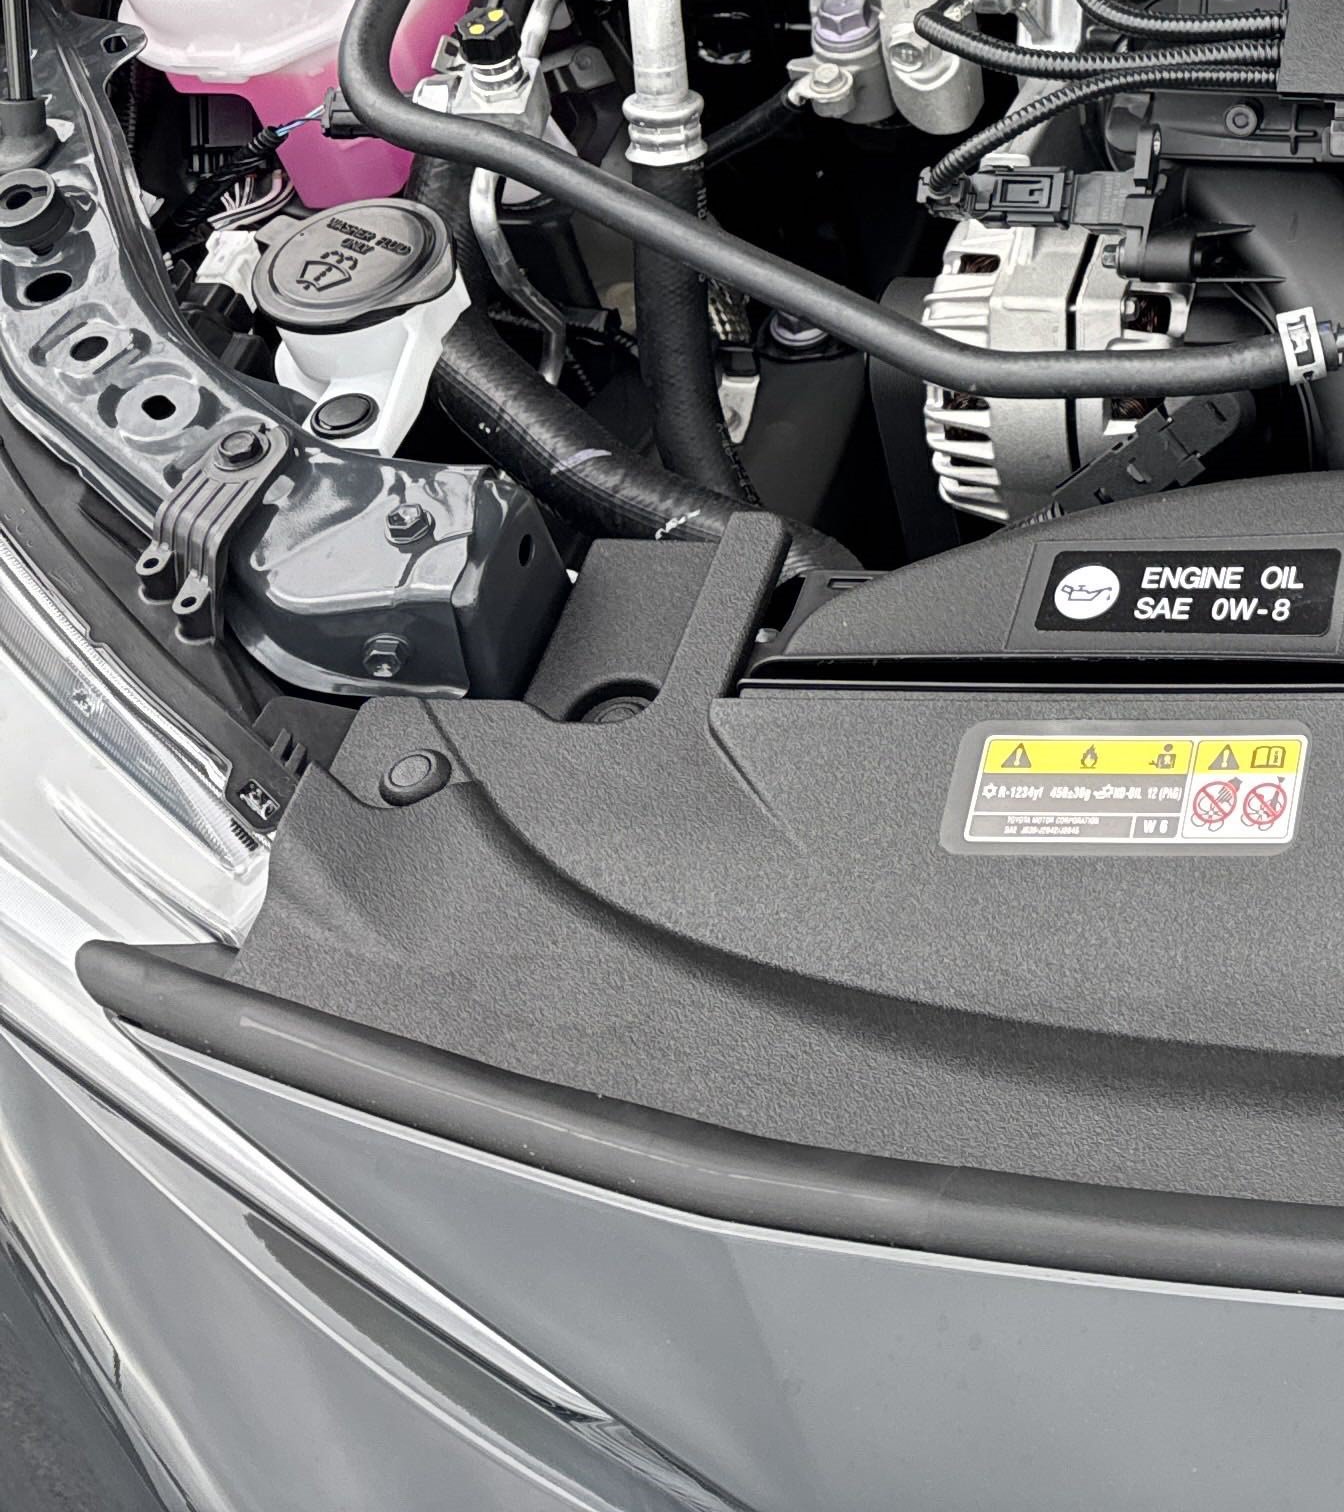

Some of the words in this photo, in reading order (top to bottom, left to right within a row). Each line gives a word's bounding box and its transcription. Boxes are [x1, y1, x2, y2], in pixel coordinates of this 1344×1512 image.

[327, 217, 376, 242] WASHER
[375, 236, 413, 256] FLUID
[340, 237, 375, 256] ONLY
[1140, 566, 1244, 590] ENGINE
[1260, 565, 1304, 590] OIL
[1133, 597, 1193, 620] SAE
[1211, 597, 1291, 621] 0W-8
[1147, 786, 1158, 800] 12
[1007, 815, 1030, 824] TOYOTA
[1031, 816, 1055, 825] MOTOR
[1055, 816, 1100, 825] CORPORATION
[1143, 819, 1157, 834] W
